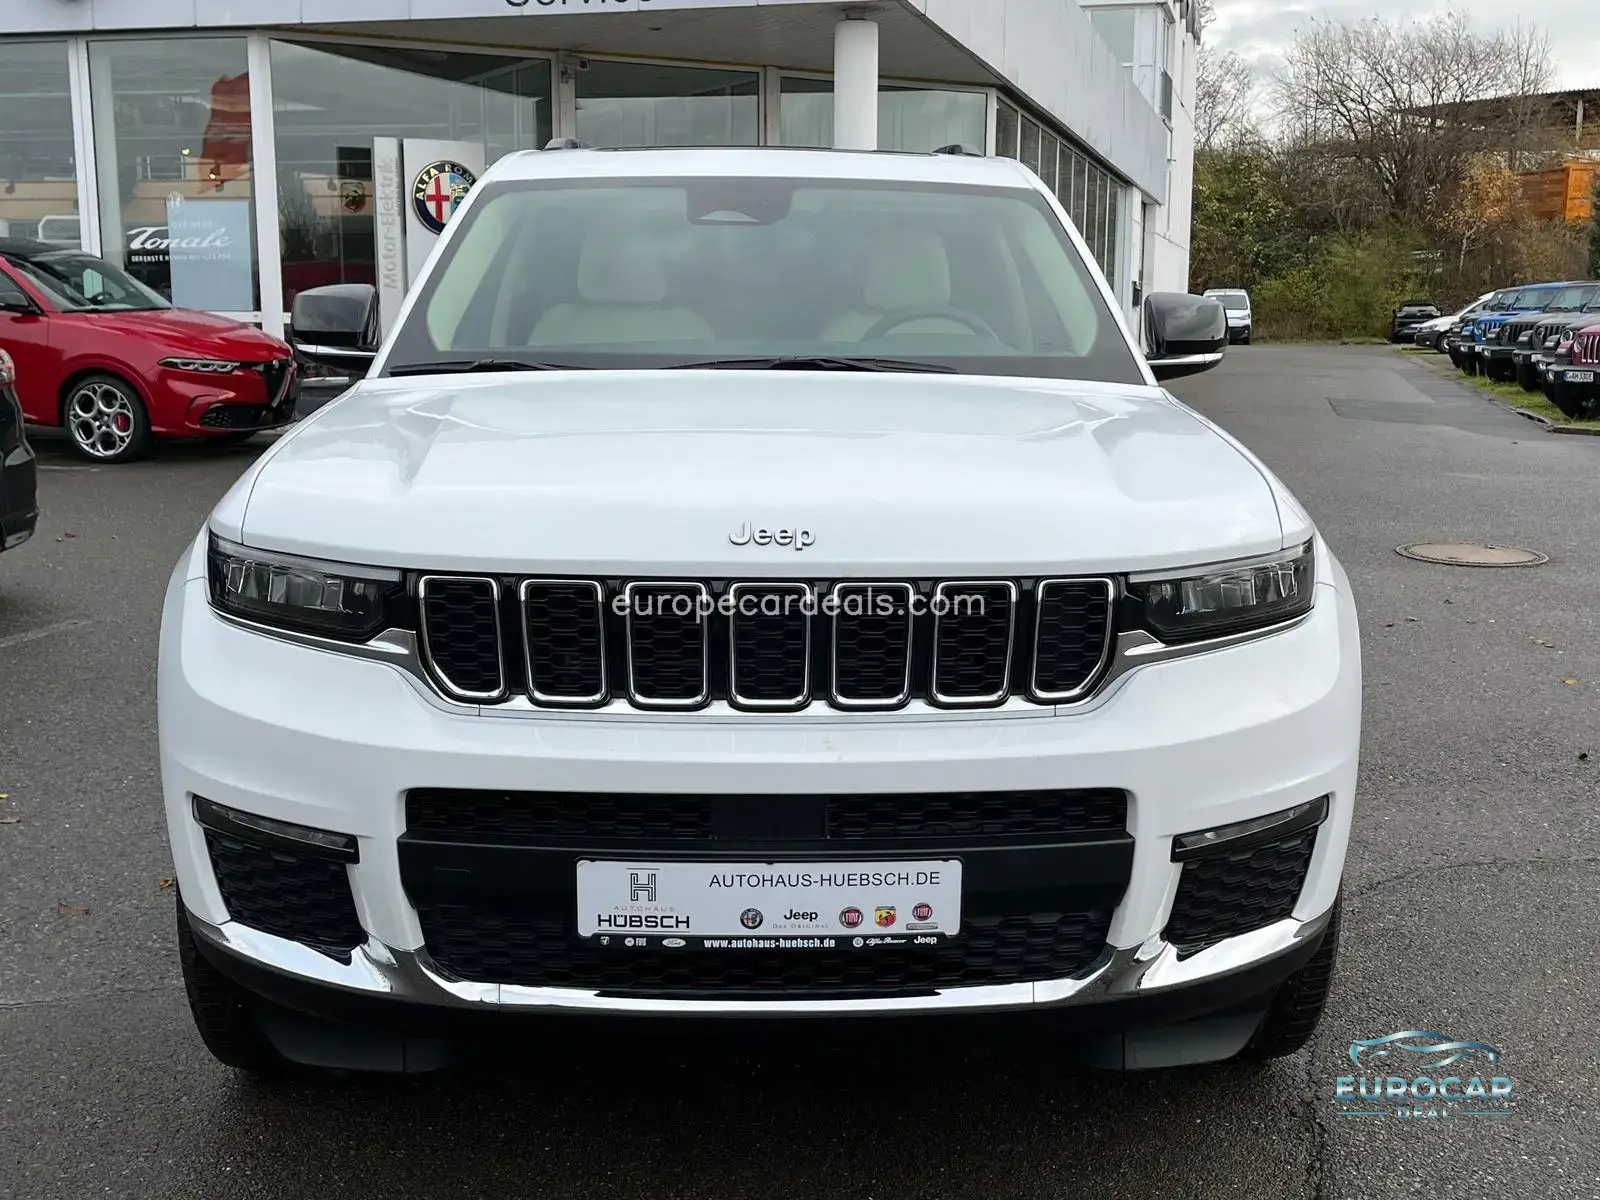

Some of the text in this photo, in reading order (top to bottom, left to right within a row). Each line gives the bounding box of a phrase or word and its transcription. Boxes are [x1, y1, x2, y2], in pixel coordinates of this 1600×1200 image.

[415, 167, 440, 200] ALFA
[377, 158, 397, 290] Motor-Elektrik
[127, 226, 234, 250] Tonale
[728, 520, 817, 551] Jeep
[708, 871, 941, 888] AUTOHAUS-HUEBSCH.DE
[597, 913, 690, 929] HÜBSCH
[783, 908, 818, 921] Jeep
[703, 938, 836, 948] www.autohaus-huebsch.de
[913, 935, 938, 945] Jeep
